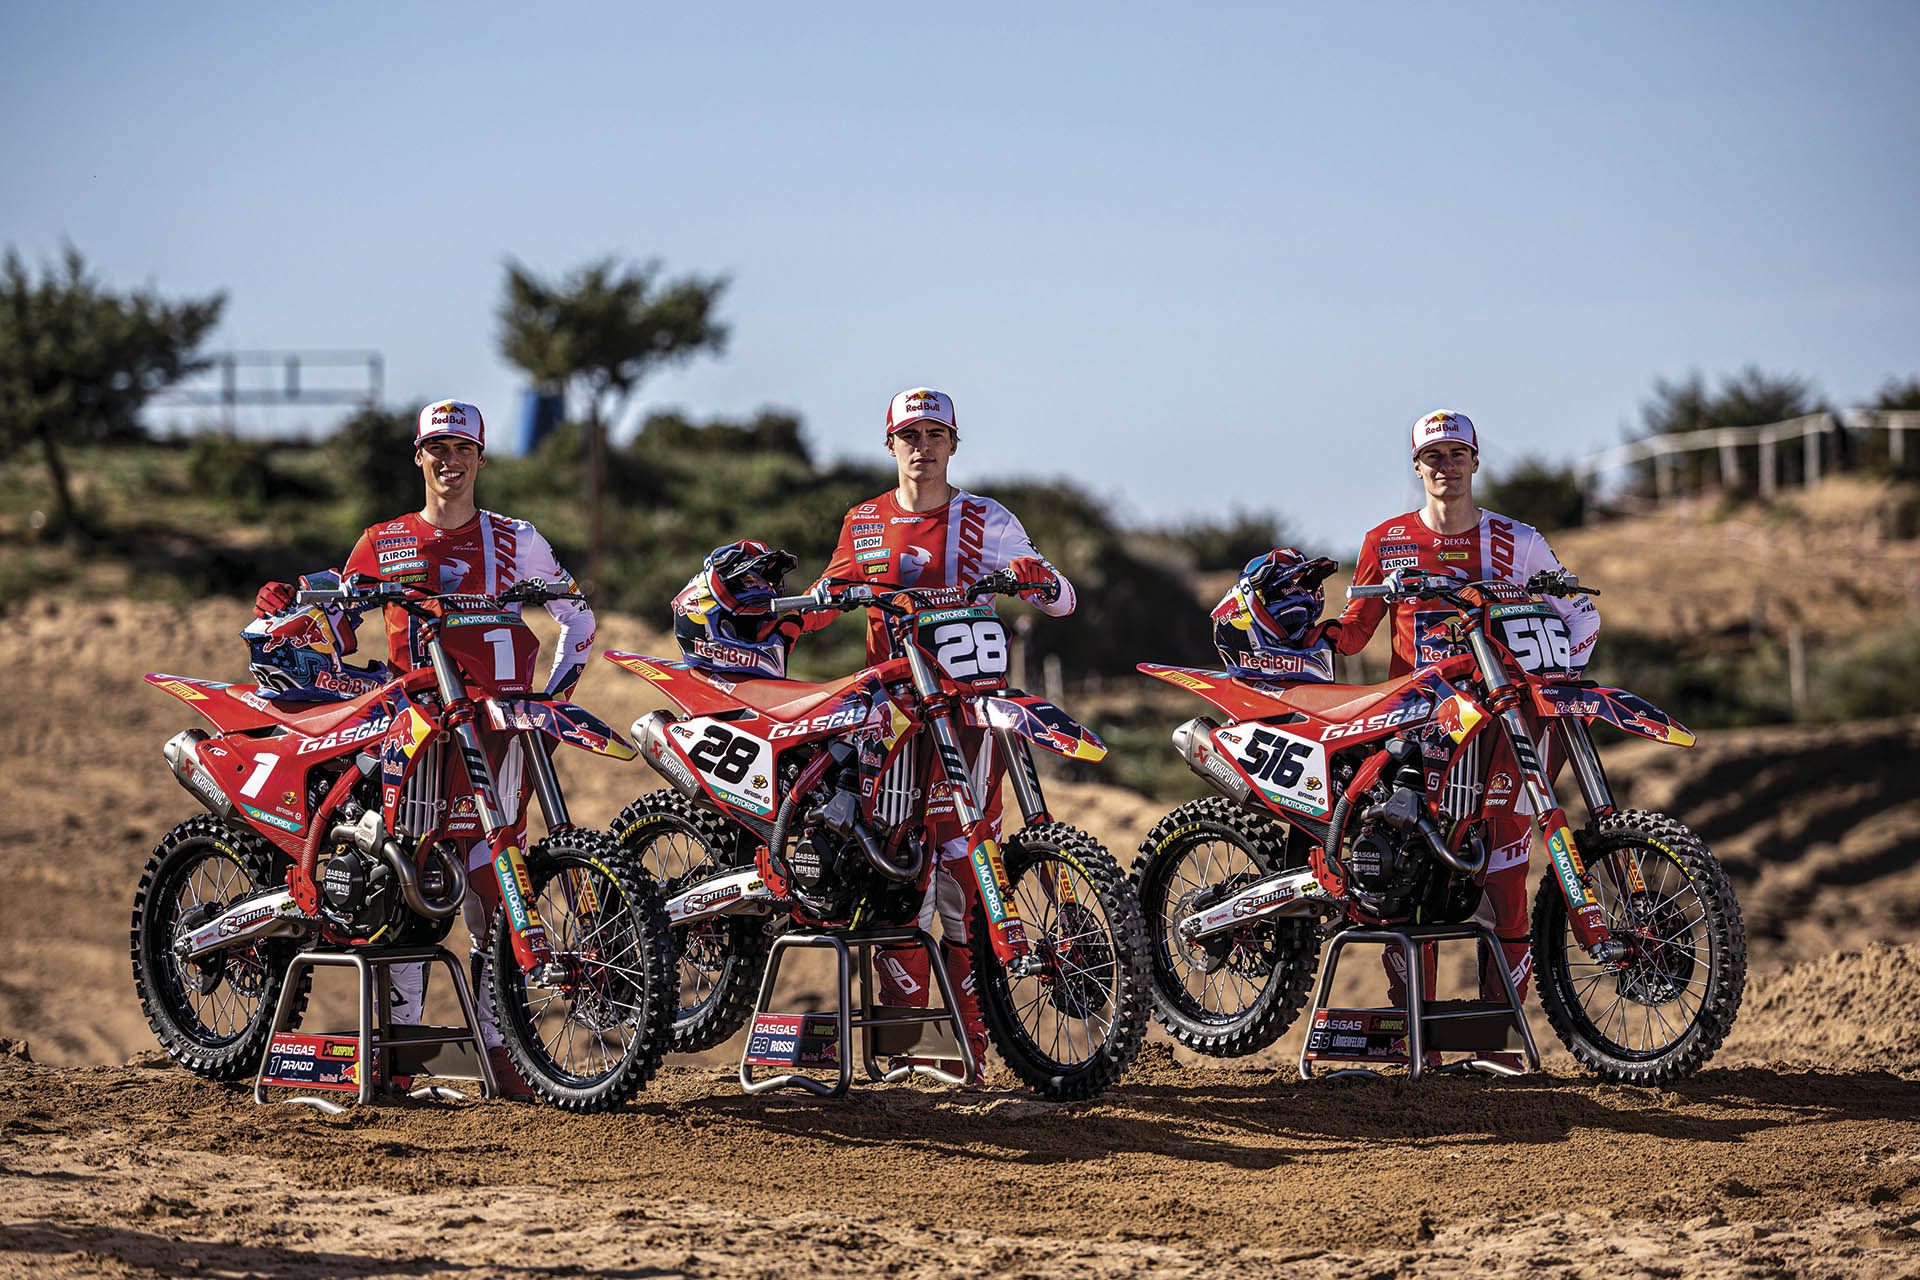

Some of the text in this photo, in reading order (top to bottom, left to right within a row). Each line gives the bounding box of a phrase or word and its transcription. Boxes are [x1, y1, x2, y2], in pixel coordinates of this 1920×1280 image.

[906, 402, 940, 412] Red Bull
[432, 416, 467, 426] Red Bull
[1425, 424, 1459, 436] Red Bull
[851, 523, 884, 532] PARTS
[376, 536, 417, 547] PARTS
[856, 538, 881, 549] AIROH
[956, 500, 986, 588] THOR
[1379, 544, 1418, 554] PARTS
[1444, 538, 1471, 546] DEKRA
[382, 549, 415, 562] AIROH
[1385, 558, 1416, 569] AIROH
[391, 561, 424, 571] MOTOREX
[930, 609, 971, 622] MOTOREX
[1501, 605, 1536, 615] MOTOREX
[459, 615, 499, 625] MOTOREX
[575, 632, 596, 653] GAS
[934, 621, 1008, 679] 28
[1502, 617, 1570, 672] 516
[483, 628, 516, 681] 1
[693, 637, 761, 668] Red Bull
[1240, 650, 1271, 671] Red
[1272, 655, 1305, 674] Bull
[315, 670, 350, 693] Red
[1554, 701, 1600, 714] Red Bull
[767, 705, 868, 740] GASGAS
[1319, 702, 1432, 742] GASGAS
[296, 716, 391, 756] GASGAS
[671, 725, 695, 739] MX2
[1218, 731, 1243, 744] MX2
[688, 724, 761, 785] 28
[1237, 728, 1314, 789] 516
[239, 752, 280, 799] 1
[727, 793, 760, 813] MOTOREX
[743, 788, 763, 800] BRISK
[1297, 790, 1318, 802] BRISK
[1280, 796, 1315, 815] MOTOREX
[260, 812, 292, 830] MOTOREX
[619, 814, 662, 845] PIRELLI
[1155, 823, 1201, 857] PIRELLI
[795, 852, 820, 861] GASGAS
[1647, 837, 1695, 881] PIRELLI
[1060, 849, 1101, 894] PIRELLI
[1556, 850, 1583, 905] MOTOREX
[501, 871, 527, 927] MOTOREX
[978, 864, 1004, 920] MOTOREX
[754, 1023, 798, 1036] GASGAS
[1315, 1019, 1363, 1031] GASGAS
[271, 1042, 317, 1056] GASGAS
[748, 1036, 795, 1054] 28 ROSSI
[1309, 1032, 1331, 1049] 516
[268, 1055, 314, 1075] 1 PRADO
